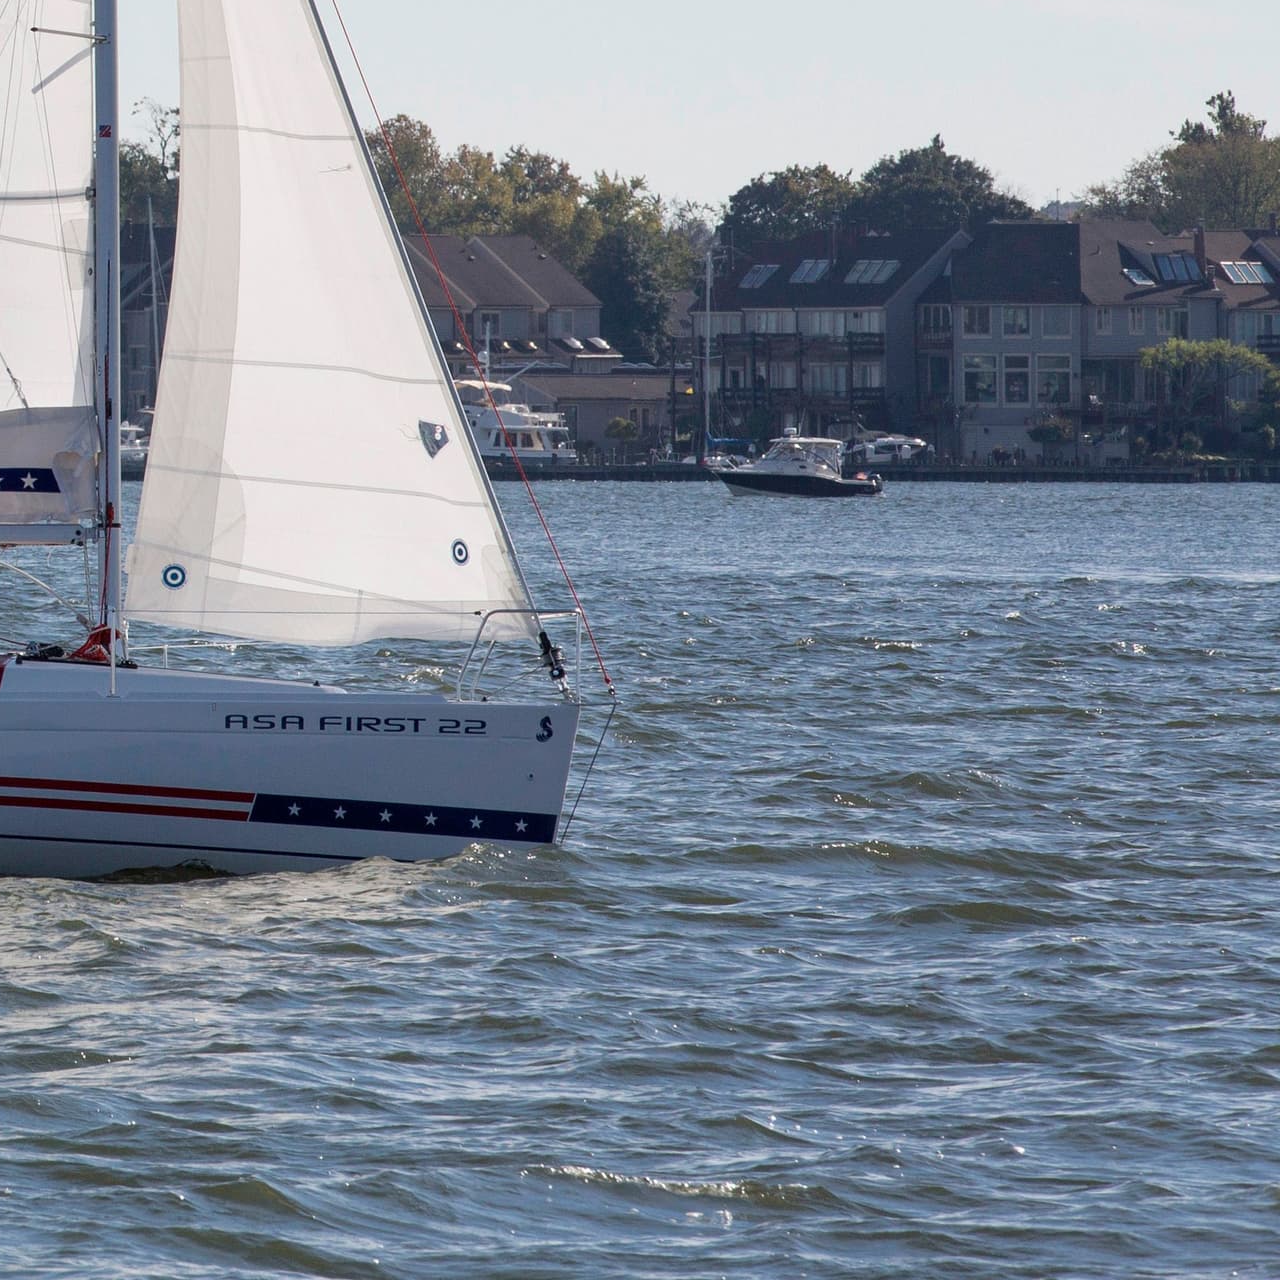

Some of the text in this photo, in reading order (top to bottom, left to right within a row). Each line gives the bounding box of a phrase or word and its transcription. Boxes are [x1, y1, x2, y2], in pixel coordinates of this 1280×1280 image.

[225, 714, 487, 735] ASA FIRST 22
